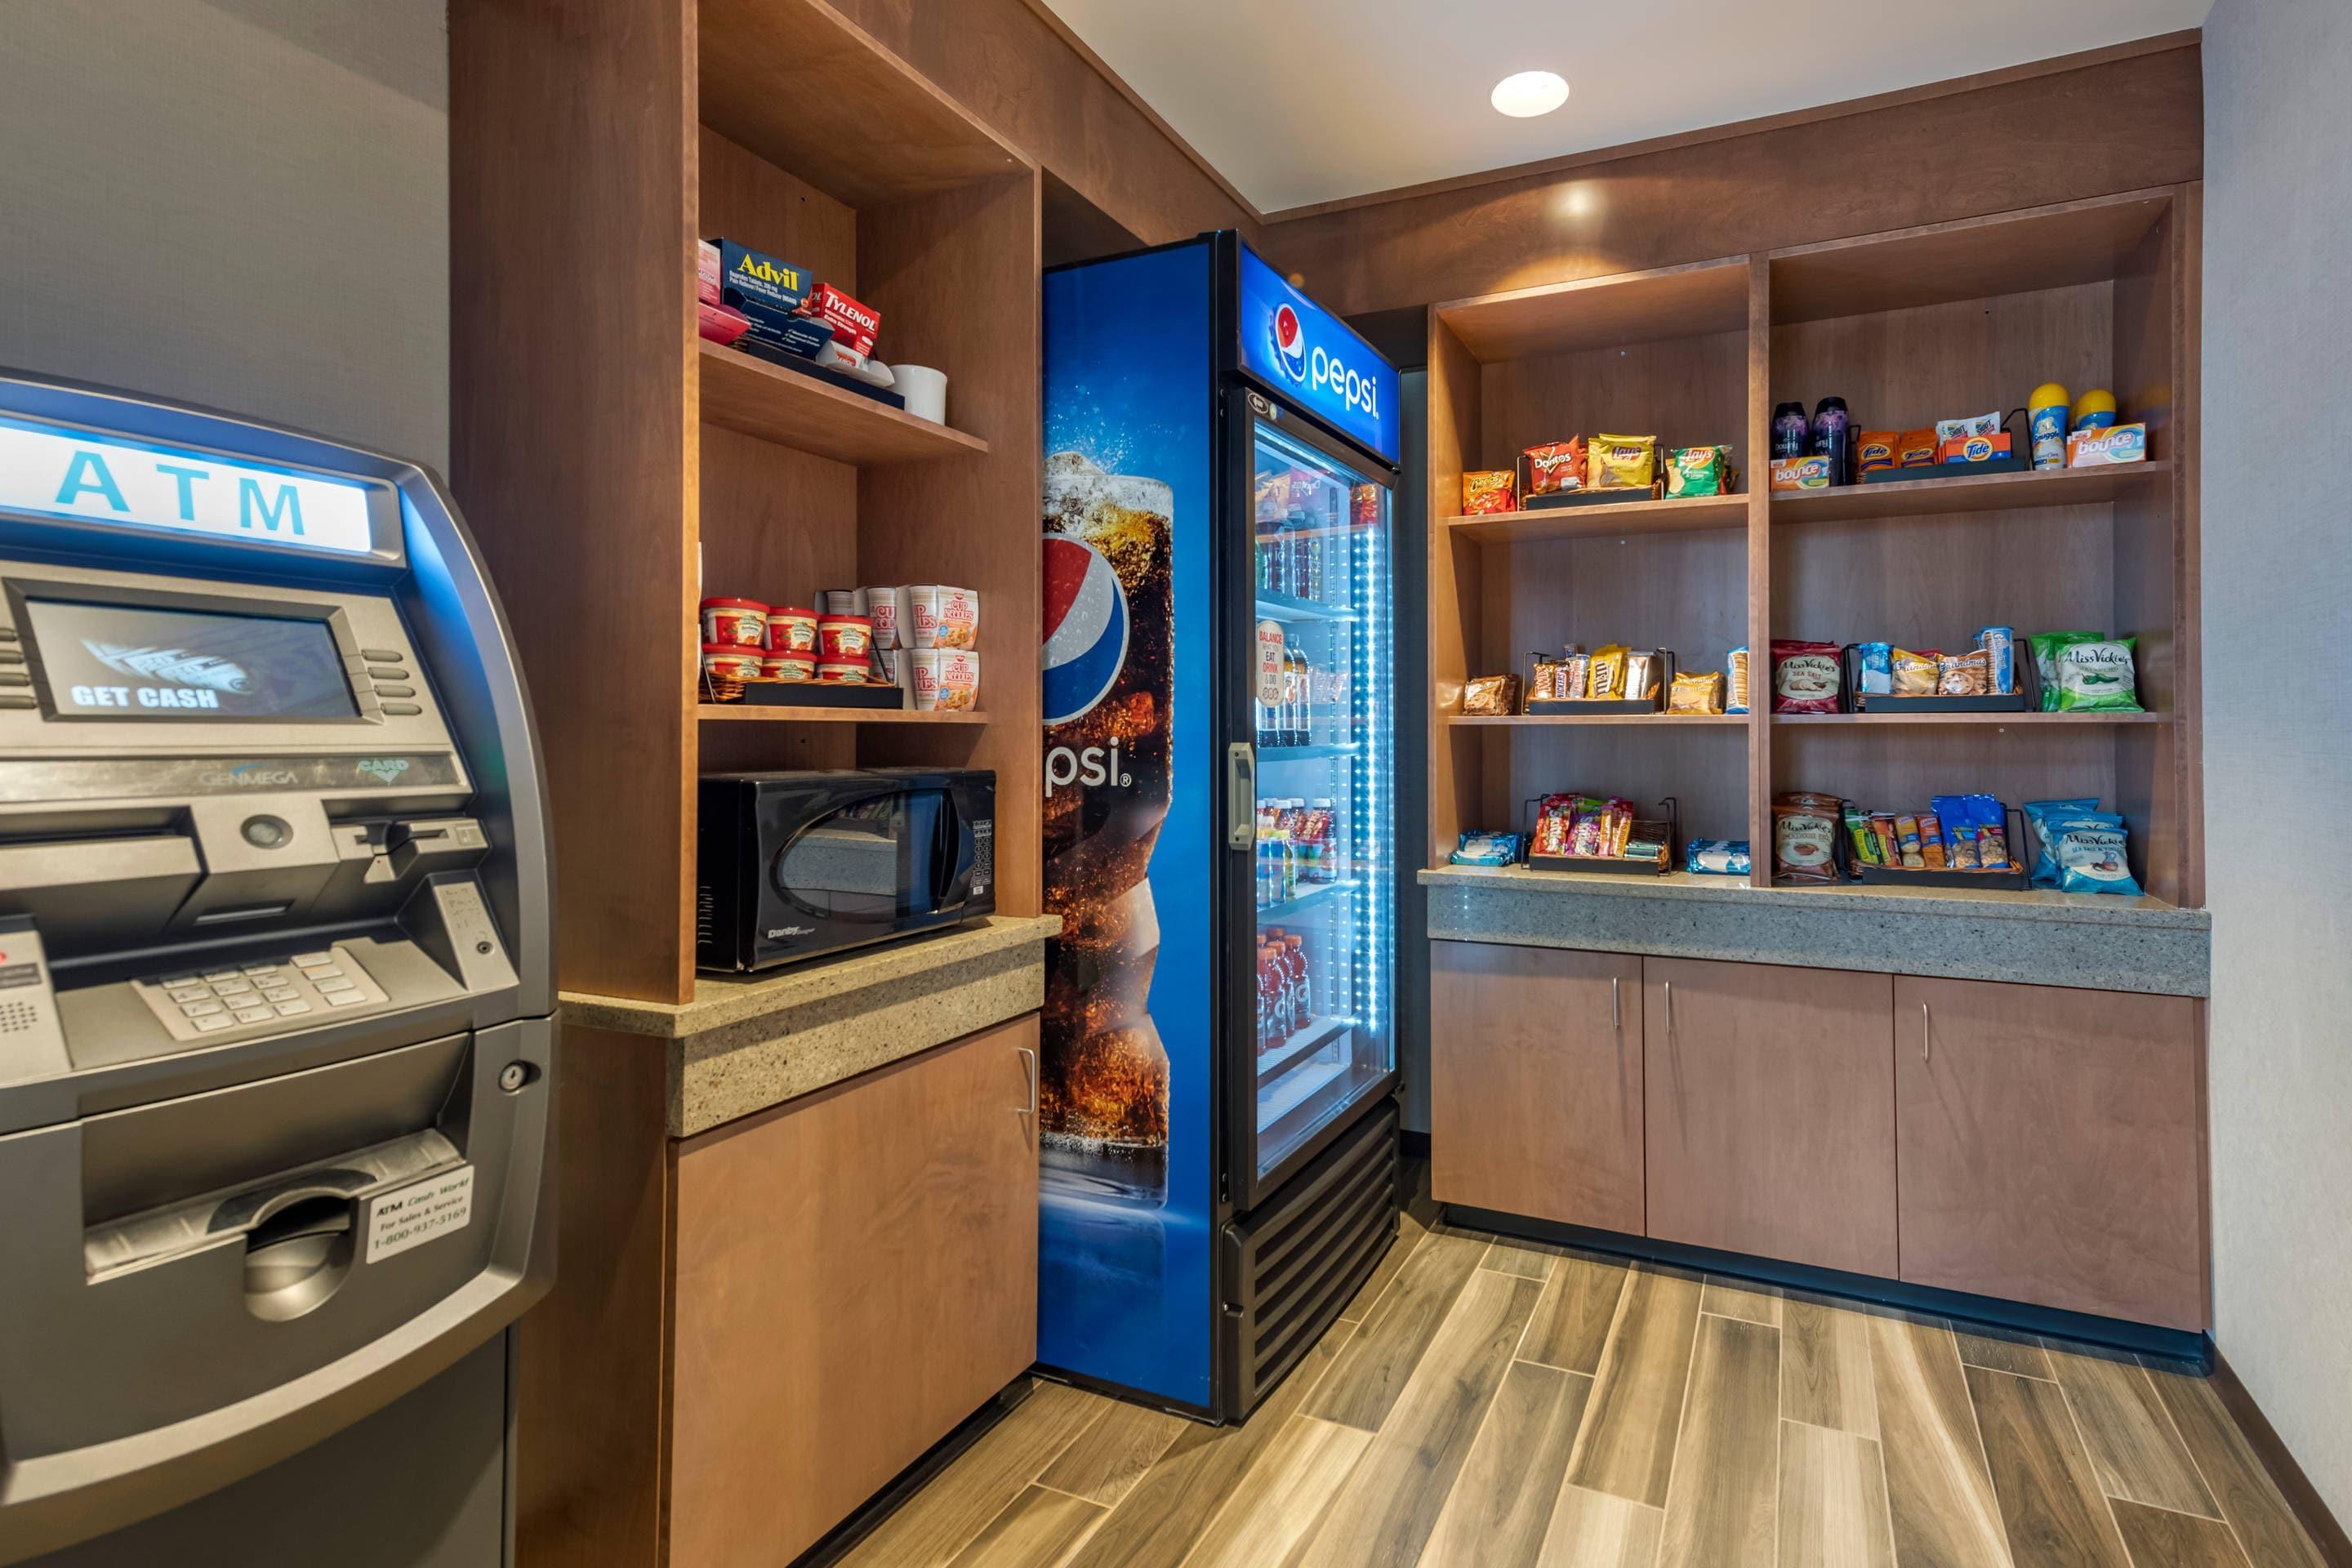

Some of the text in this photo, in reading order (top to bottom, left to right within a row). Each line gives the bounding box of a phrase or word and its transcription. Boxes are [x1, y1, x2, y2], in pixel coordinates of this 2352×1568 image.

[737, 254, 798, 291] Advil
[825, 291, 876, 332] TYLENOL
[1312, 345, 1379, 419] pepsi
[1967, 443, 1989, 458] Tide
[2078, 432, 2136, 455] bounce
[1864, 447, 1887, 459] Tide
[1905, 449, 1931, 460] Tide
[1535, 452, 1572, 469] Doritos
[1775, 463, 1820, 483] bounce
[55, 450, 305, 536] ATM
[950, 600, 969, 611] CUP
[943, 608, 974, 621] NOODLES
[1258, 630, 1282, 644] BALANCE
[1266, 651, 1276, 662] EAT
[2065, 650, 2093, 663] Miss
[952, 663, 969, 673] CUP
[1263, 662, 1279, 675] DRINK
[945, 670, 974, 682] NOODLES
[1535, 663, 1552, 693] TWIX
[70, 685, 220, 709] GET CASH
[358, 760, 410, 771] CARD
[199, 771, 299, 786] GENMEGA
[2065, 834, 2091, 844] Miss
[768, 926, 800, 939] Danby
[376, 1178, 470, 1217] ATM Cash World
[380, 1196, 464, 1232] For Sales & Service
